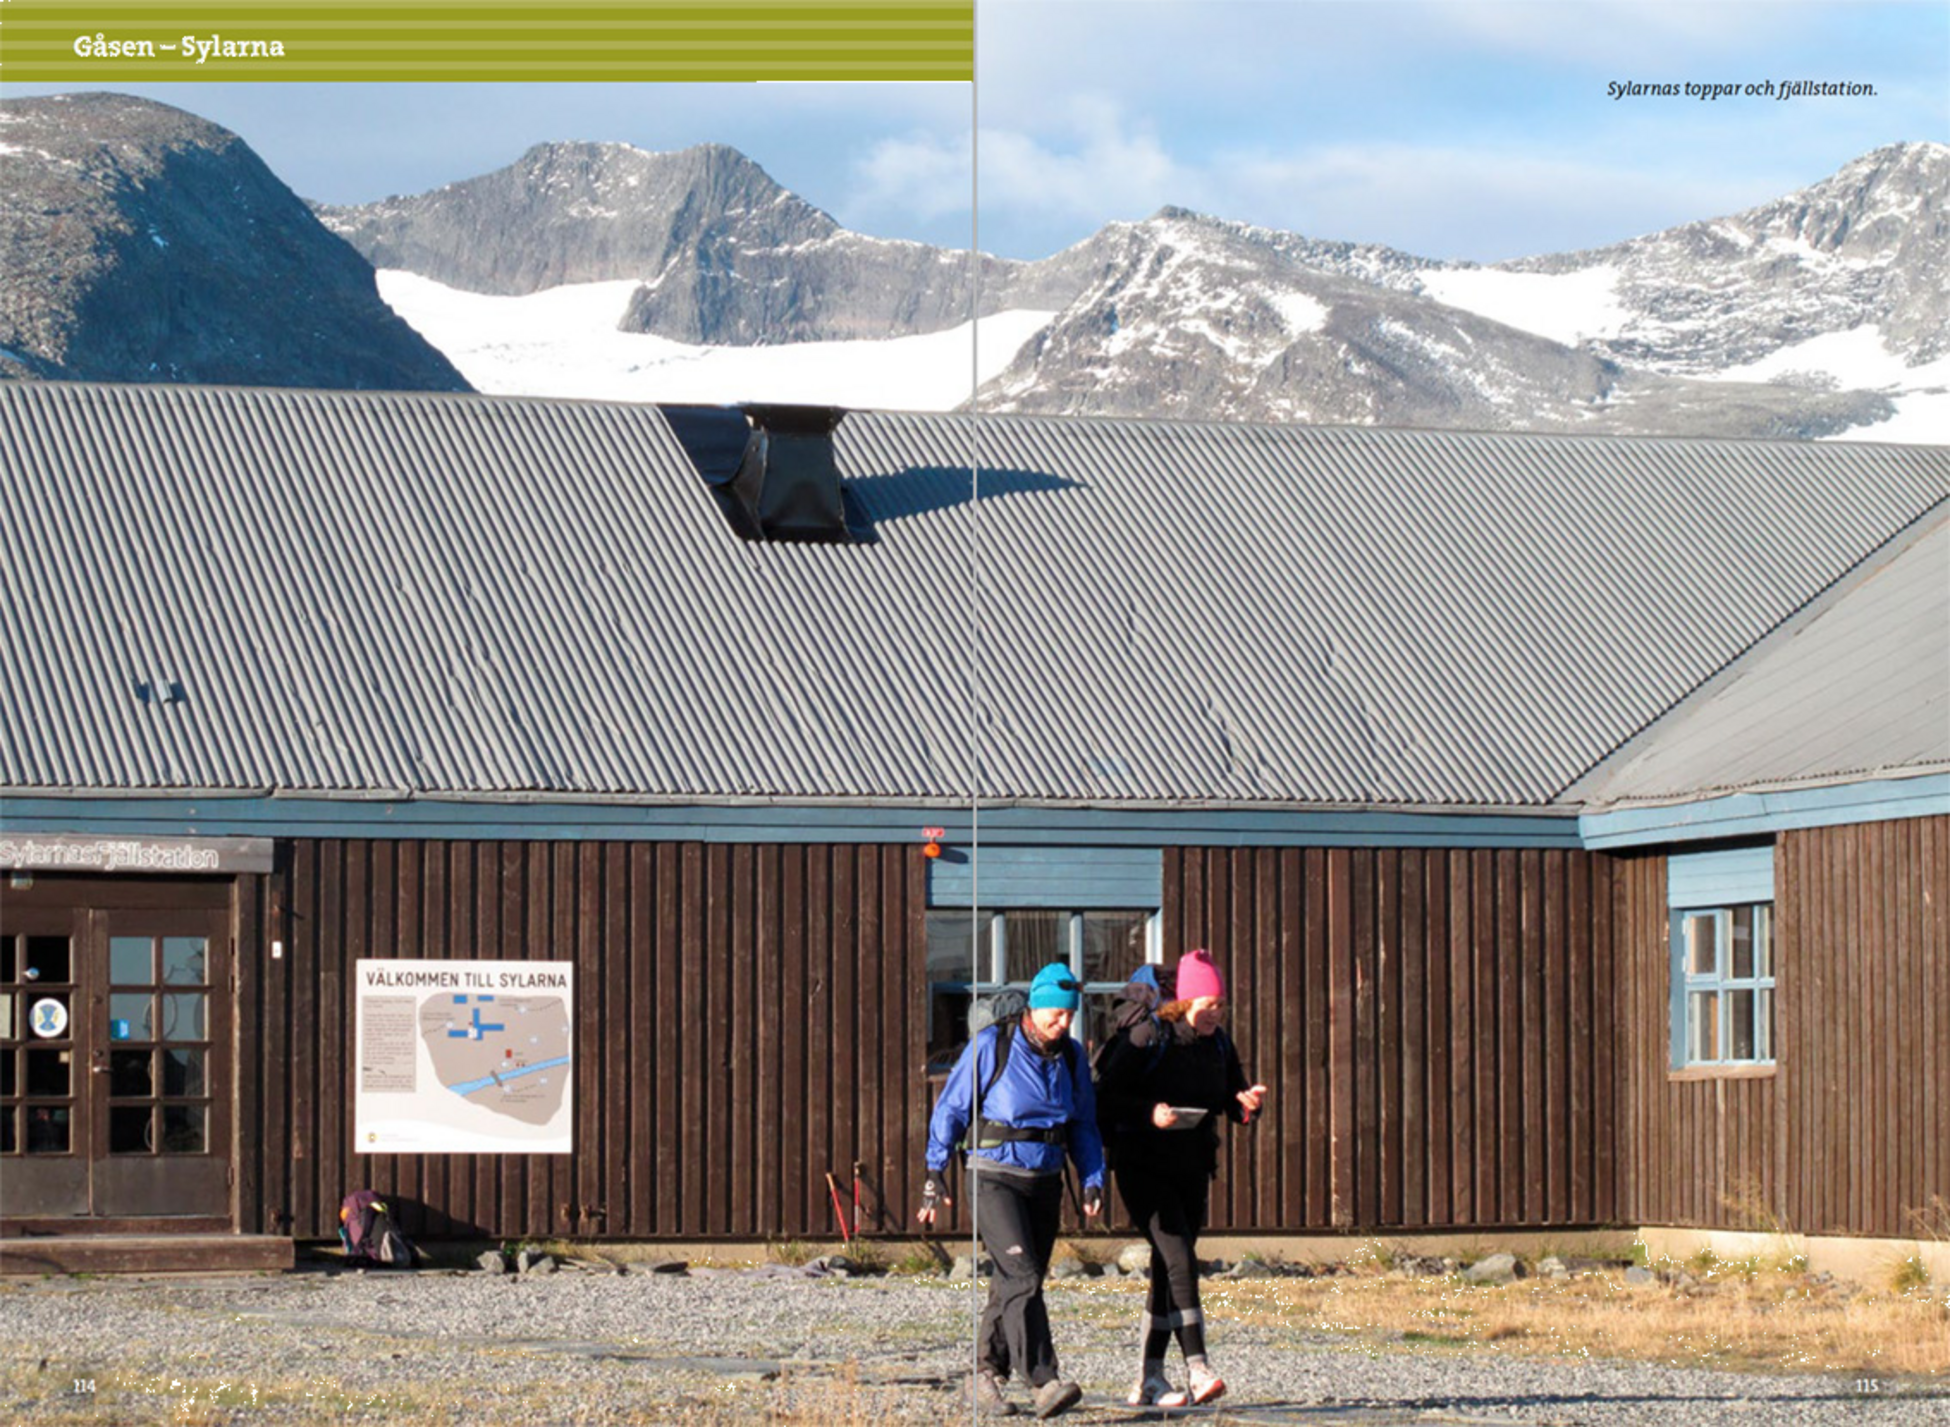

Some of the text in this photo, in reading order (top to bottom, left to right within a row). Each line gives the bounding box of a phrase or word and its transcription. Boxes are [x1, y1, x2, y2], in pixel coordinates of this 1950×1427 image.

[366, 967, 567, 988] VÄLKOMMEN TILL SYLARNA
